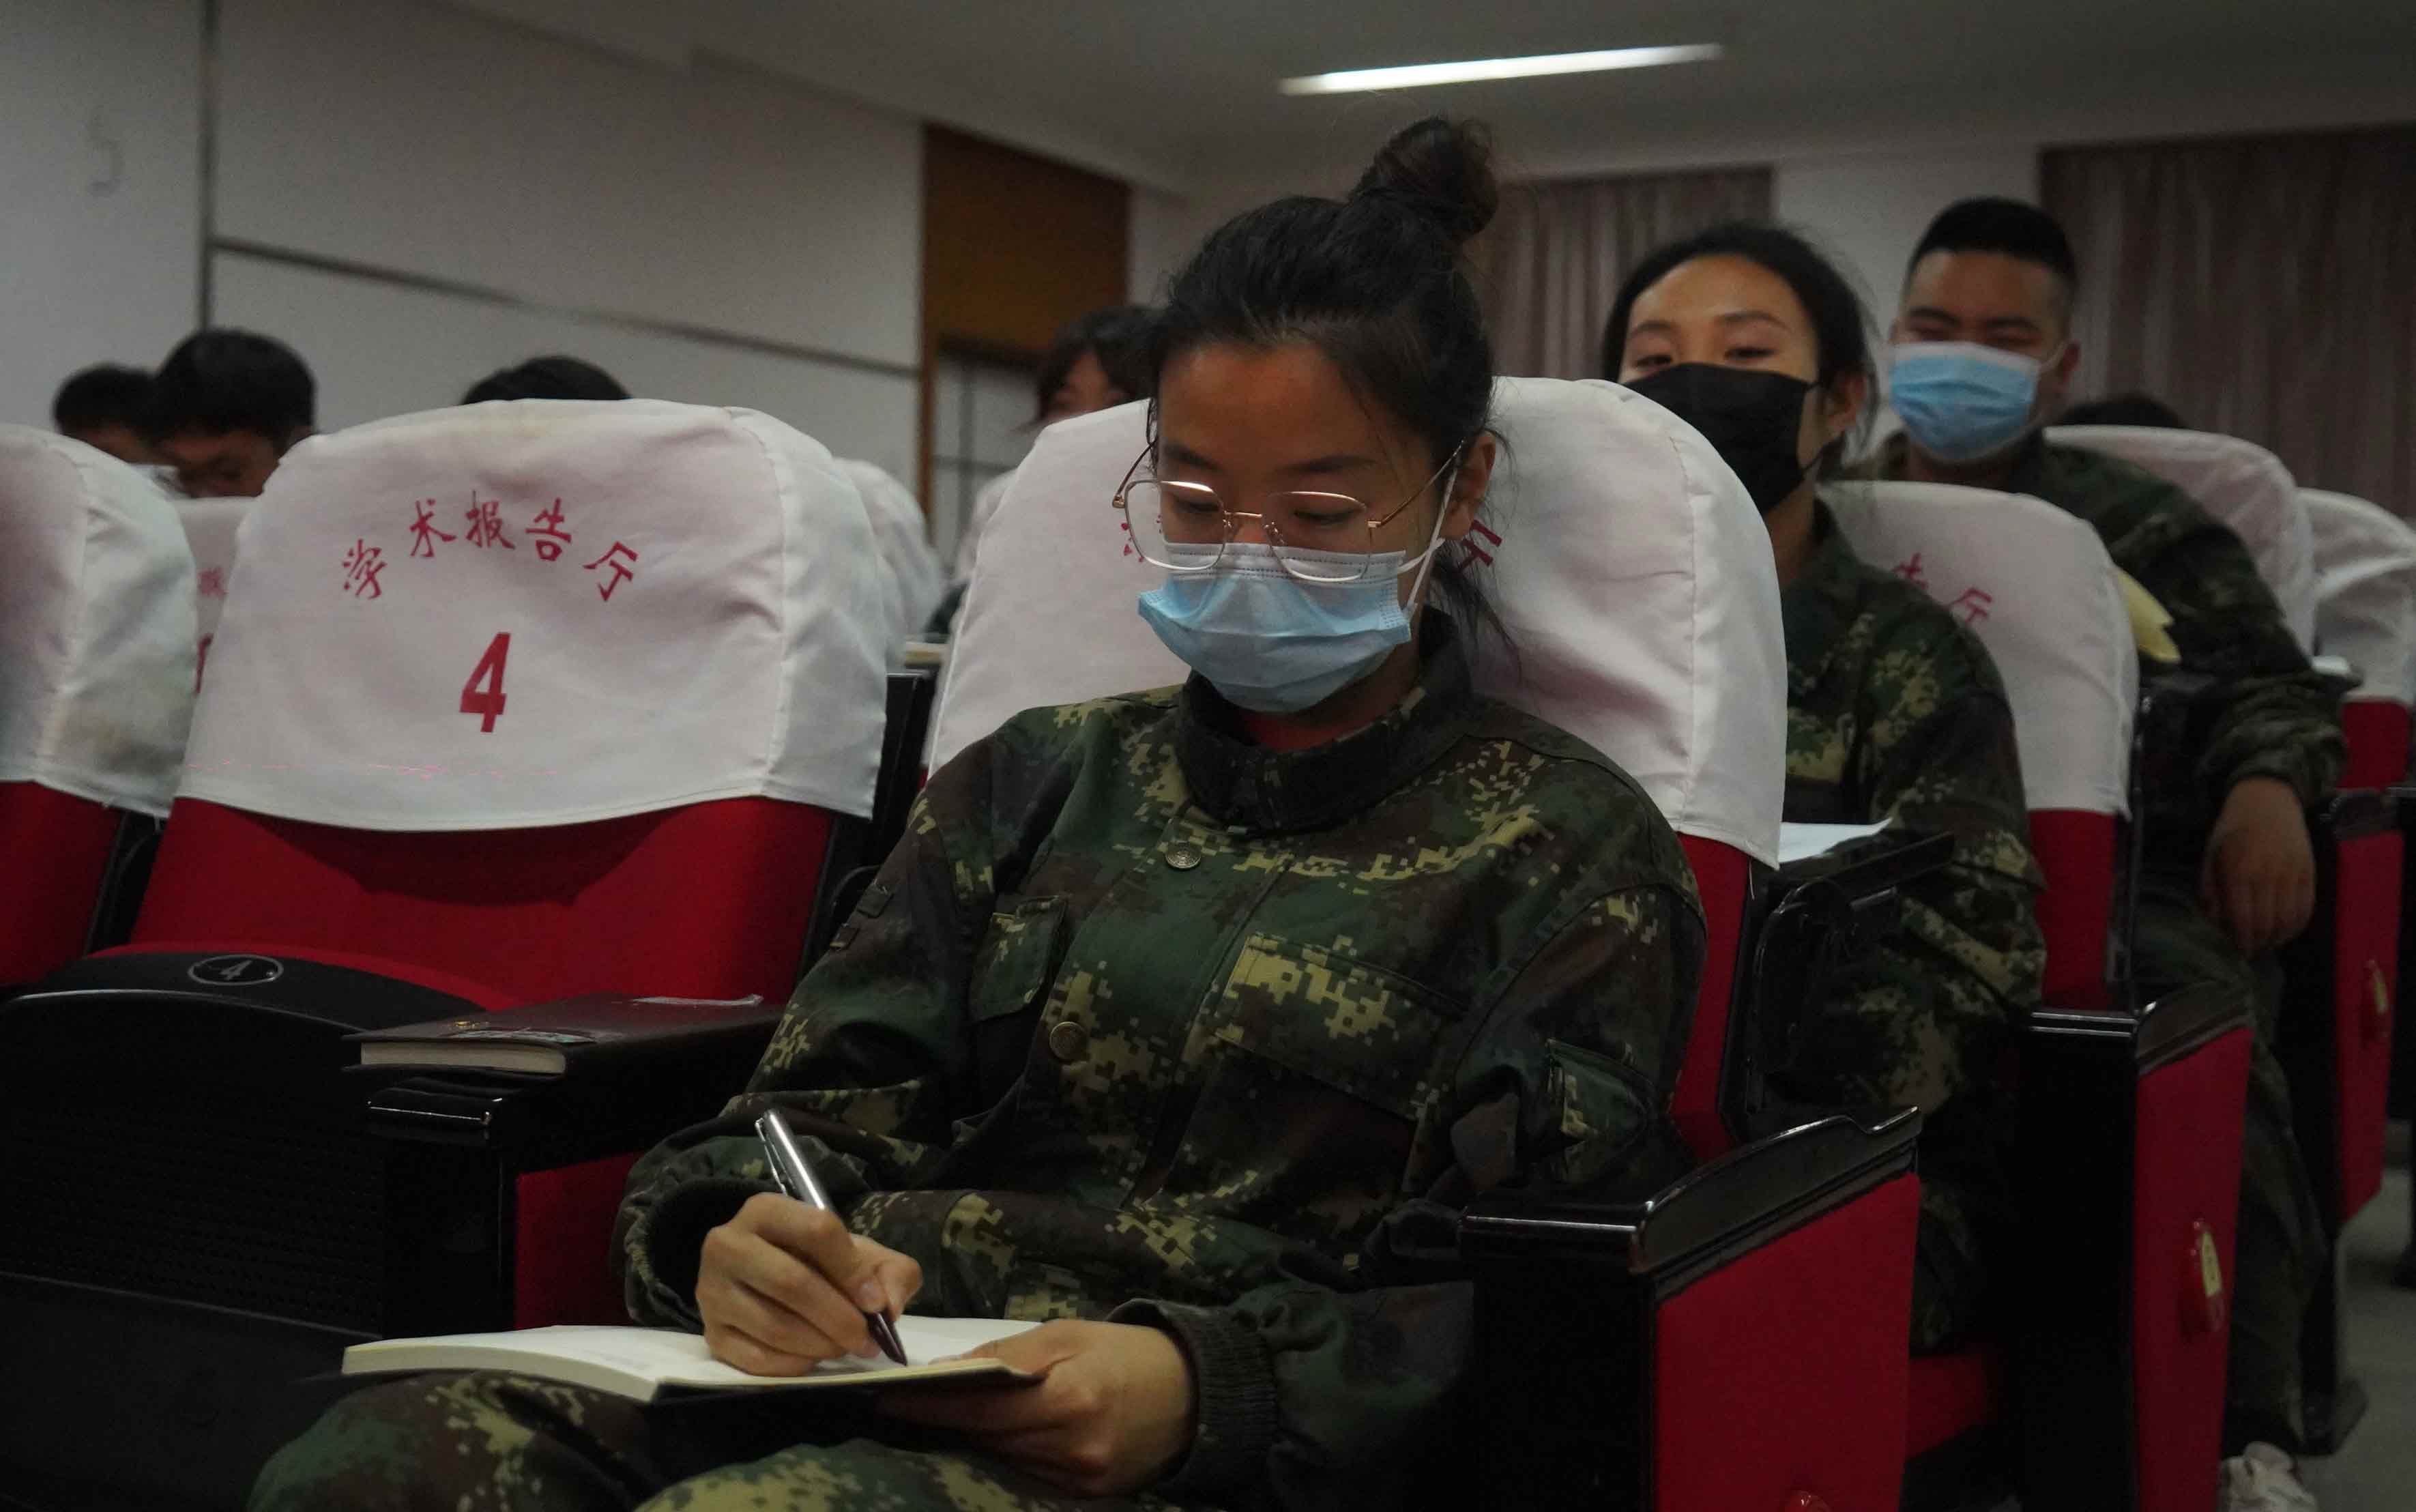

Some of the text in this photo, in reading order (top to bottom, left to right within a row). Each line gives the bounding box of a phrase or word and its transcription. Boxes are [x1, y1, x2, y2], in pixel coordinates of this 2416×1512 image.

[343, 490, 639, 602] 学术报告厅
[459, 631, 512, 733] 4
[218, 959, 254, 981] 4
